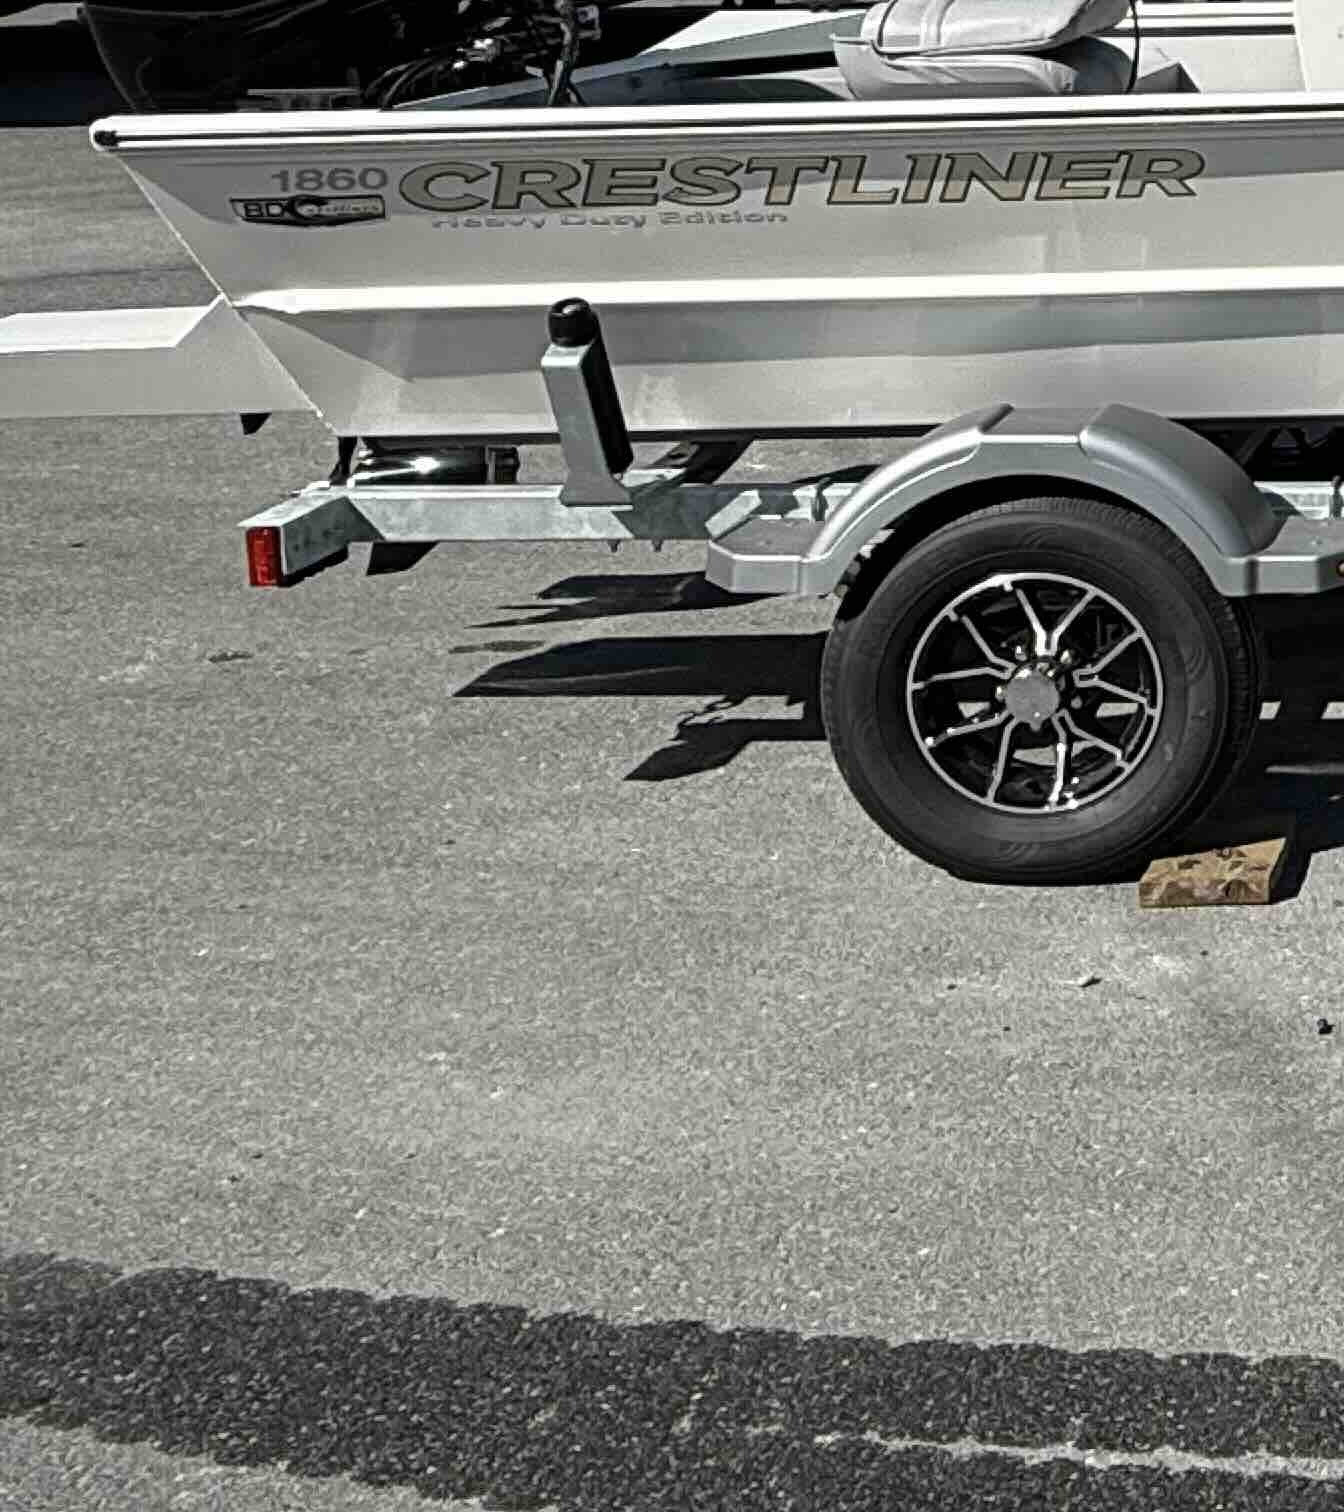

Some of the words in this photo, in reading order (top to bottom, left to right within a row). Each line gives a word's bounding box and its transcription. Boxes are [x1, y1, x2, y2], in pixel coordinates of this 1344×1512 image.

[271, 168, 387, 192] 1860
[399, 147, 1205, 211] CRESTLINER
[658, 209, 789, 225] Edition
